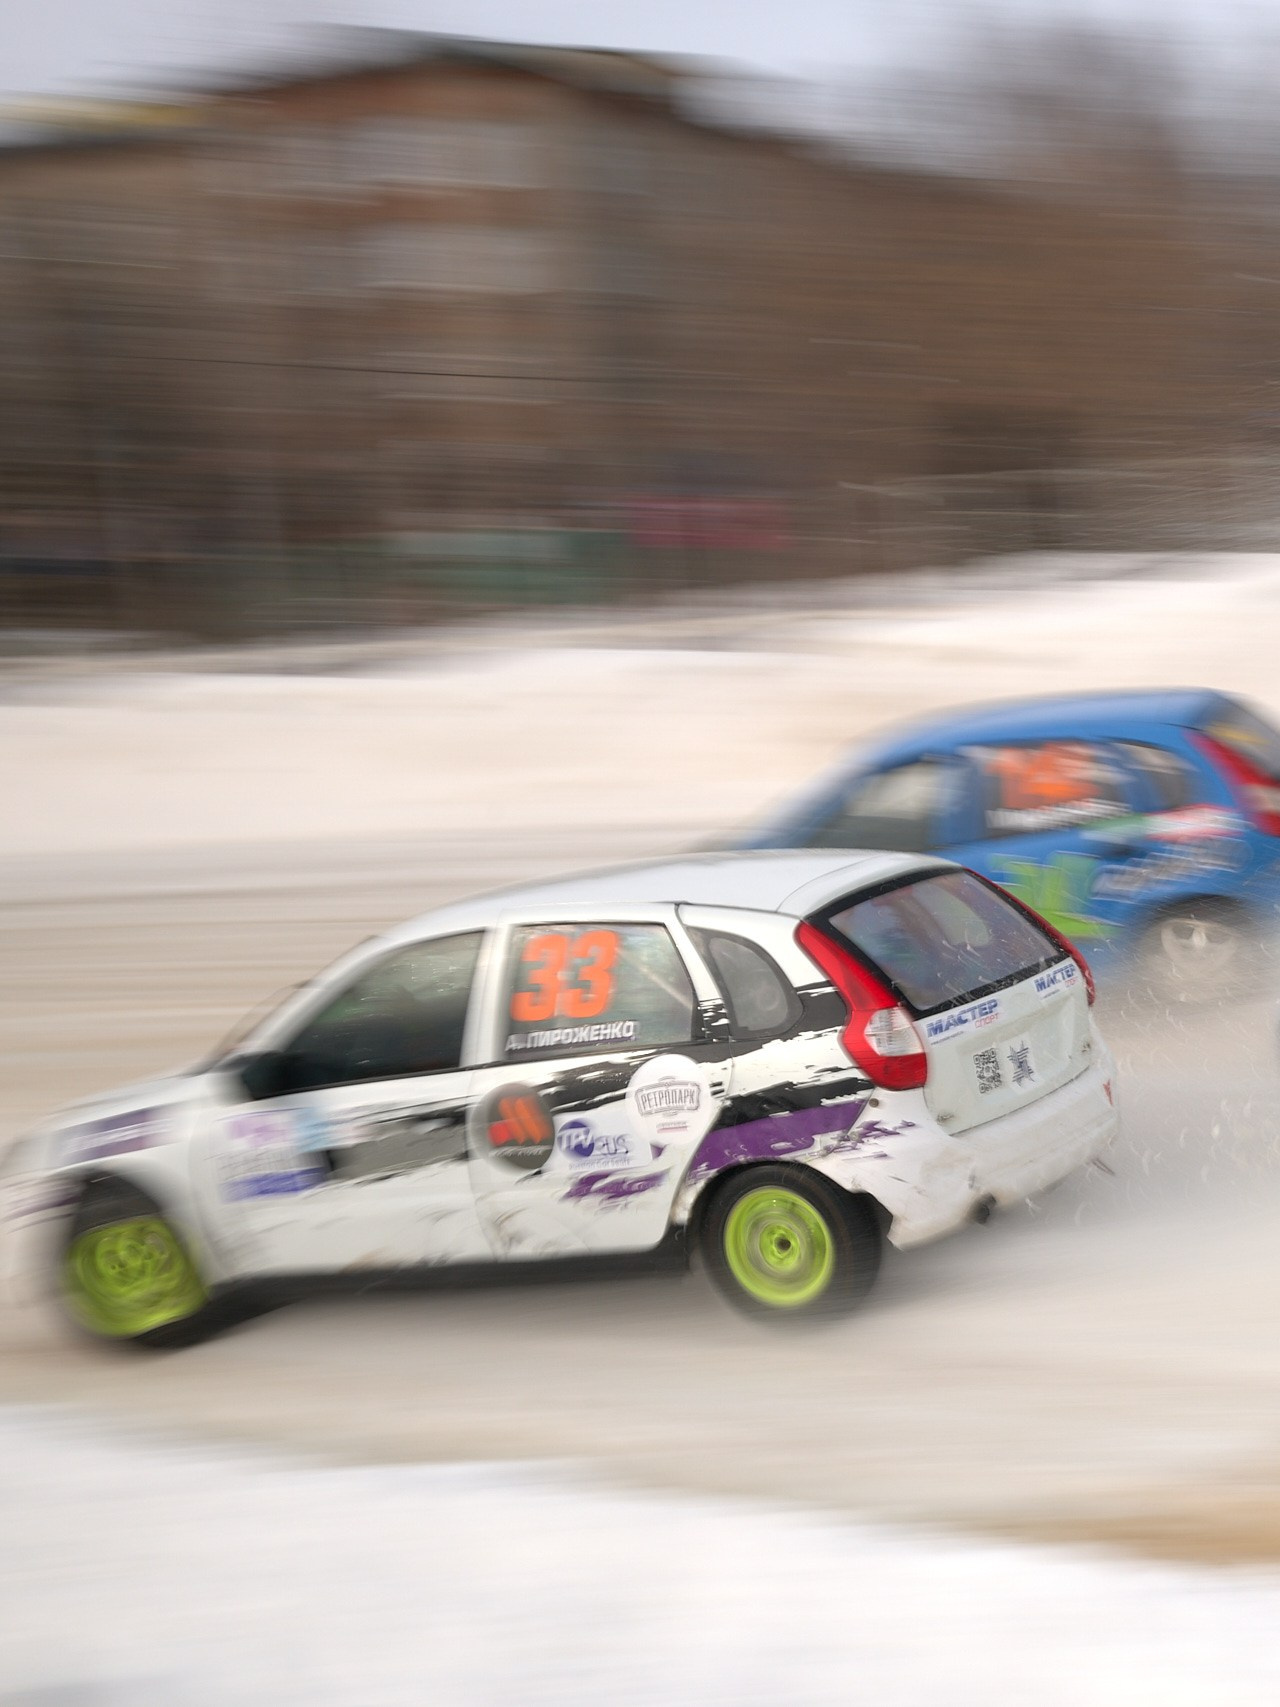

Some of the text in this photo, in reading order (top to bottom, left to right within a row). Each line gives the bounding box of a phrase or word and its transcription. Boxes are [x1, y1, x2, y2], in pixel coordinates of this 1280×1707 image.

[510, 929, 619, 1022] 33
[1034, 963, 1076, 993] МАСТЕР
[926, 998, 998, 1038] МАСТЕР
[526, 1020, 638, 1048] ПИРОЖЕНКО
[640, 1088, 695, 1112] РЕТРОПАРК
